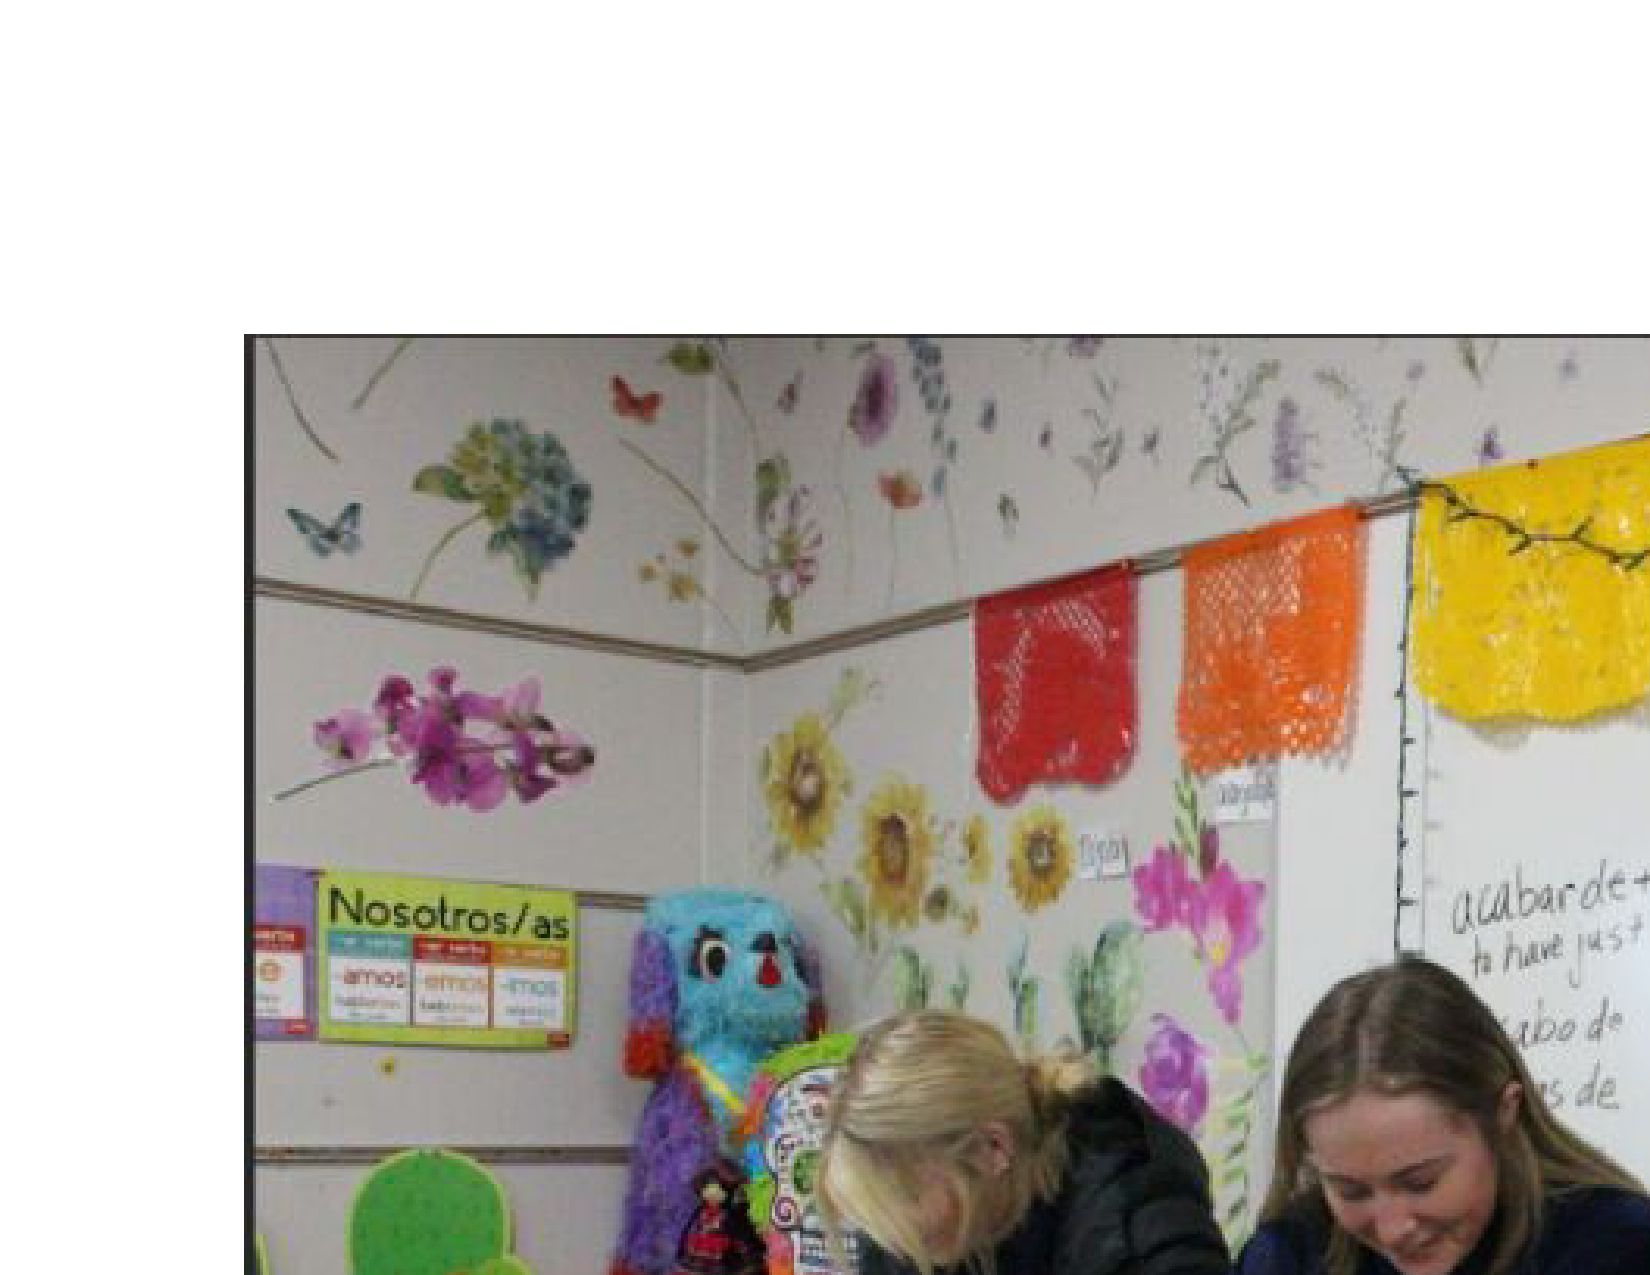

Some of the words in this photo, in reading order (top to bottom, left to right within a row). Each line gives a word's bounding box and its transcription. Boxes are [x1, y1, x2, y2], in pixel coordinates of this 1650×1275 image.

[328, 886, 570, 939] Nosotros/as
[1452, 861, 1576, 935] acabar
[1503, 931, 1563, 974] have
[1568, 913, 1644, 989] just
